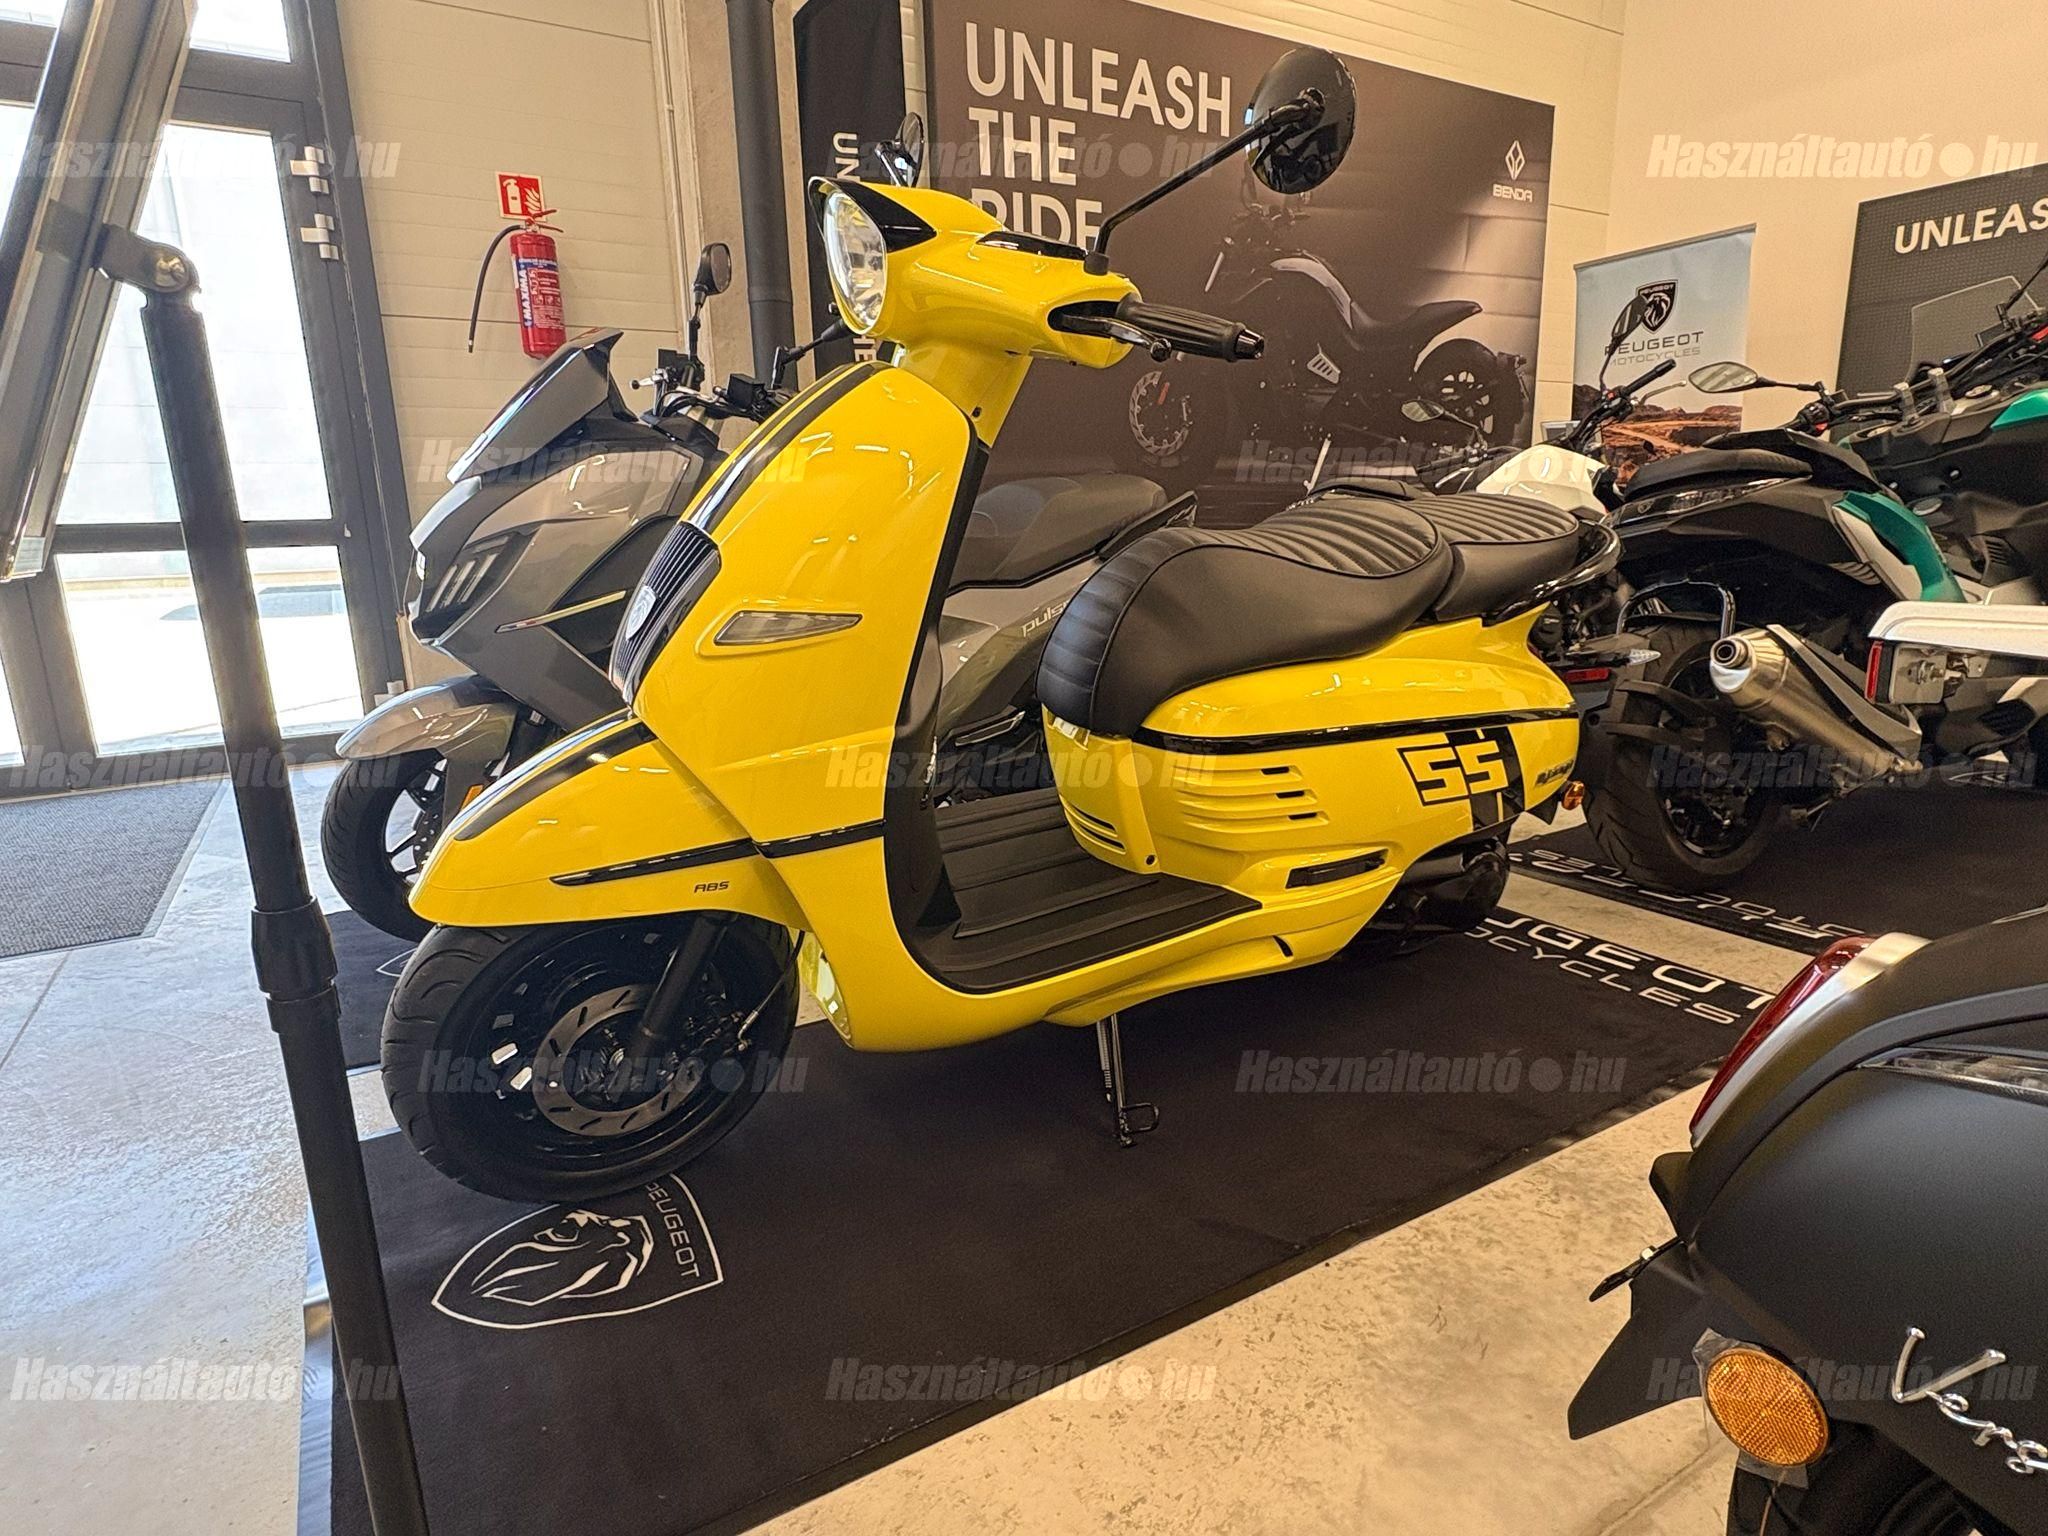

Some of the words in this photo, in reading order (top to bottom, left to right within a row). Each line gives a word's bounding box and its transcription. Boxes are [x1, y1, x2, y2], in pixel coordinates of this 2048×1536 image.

[966, 22, 1230, 137] UNLEASH
[969, 107, 1077, 186] THE
[1492, 183, 1533, 203] BENDA
[1894, 197, 2048, 254] UNLEAS
[518, 269, 532, 320] MAXIMA
[694, 881, 729, 893] ABS
[1484, 916, 1776, 1010] UGEOT
